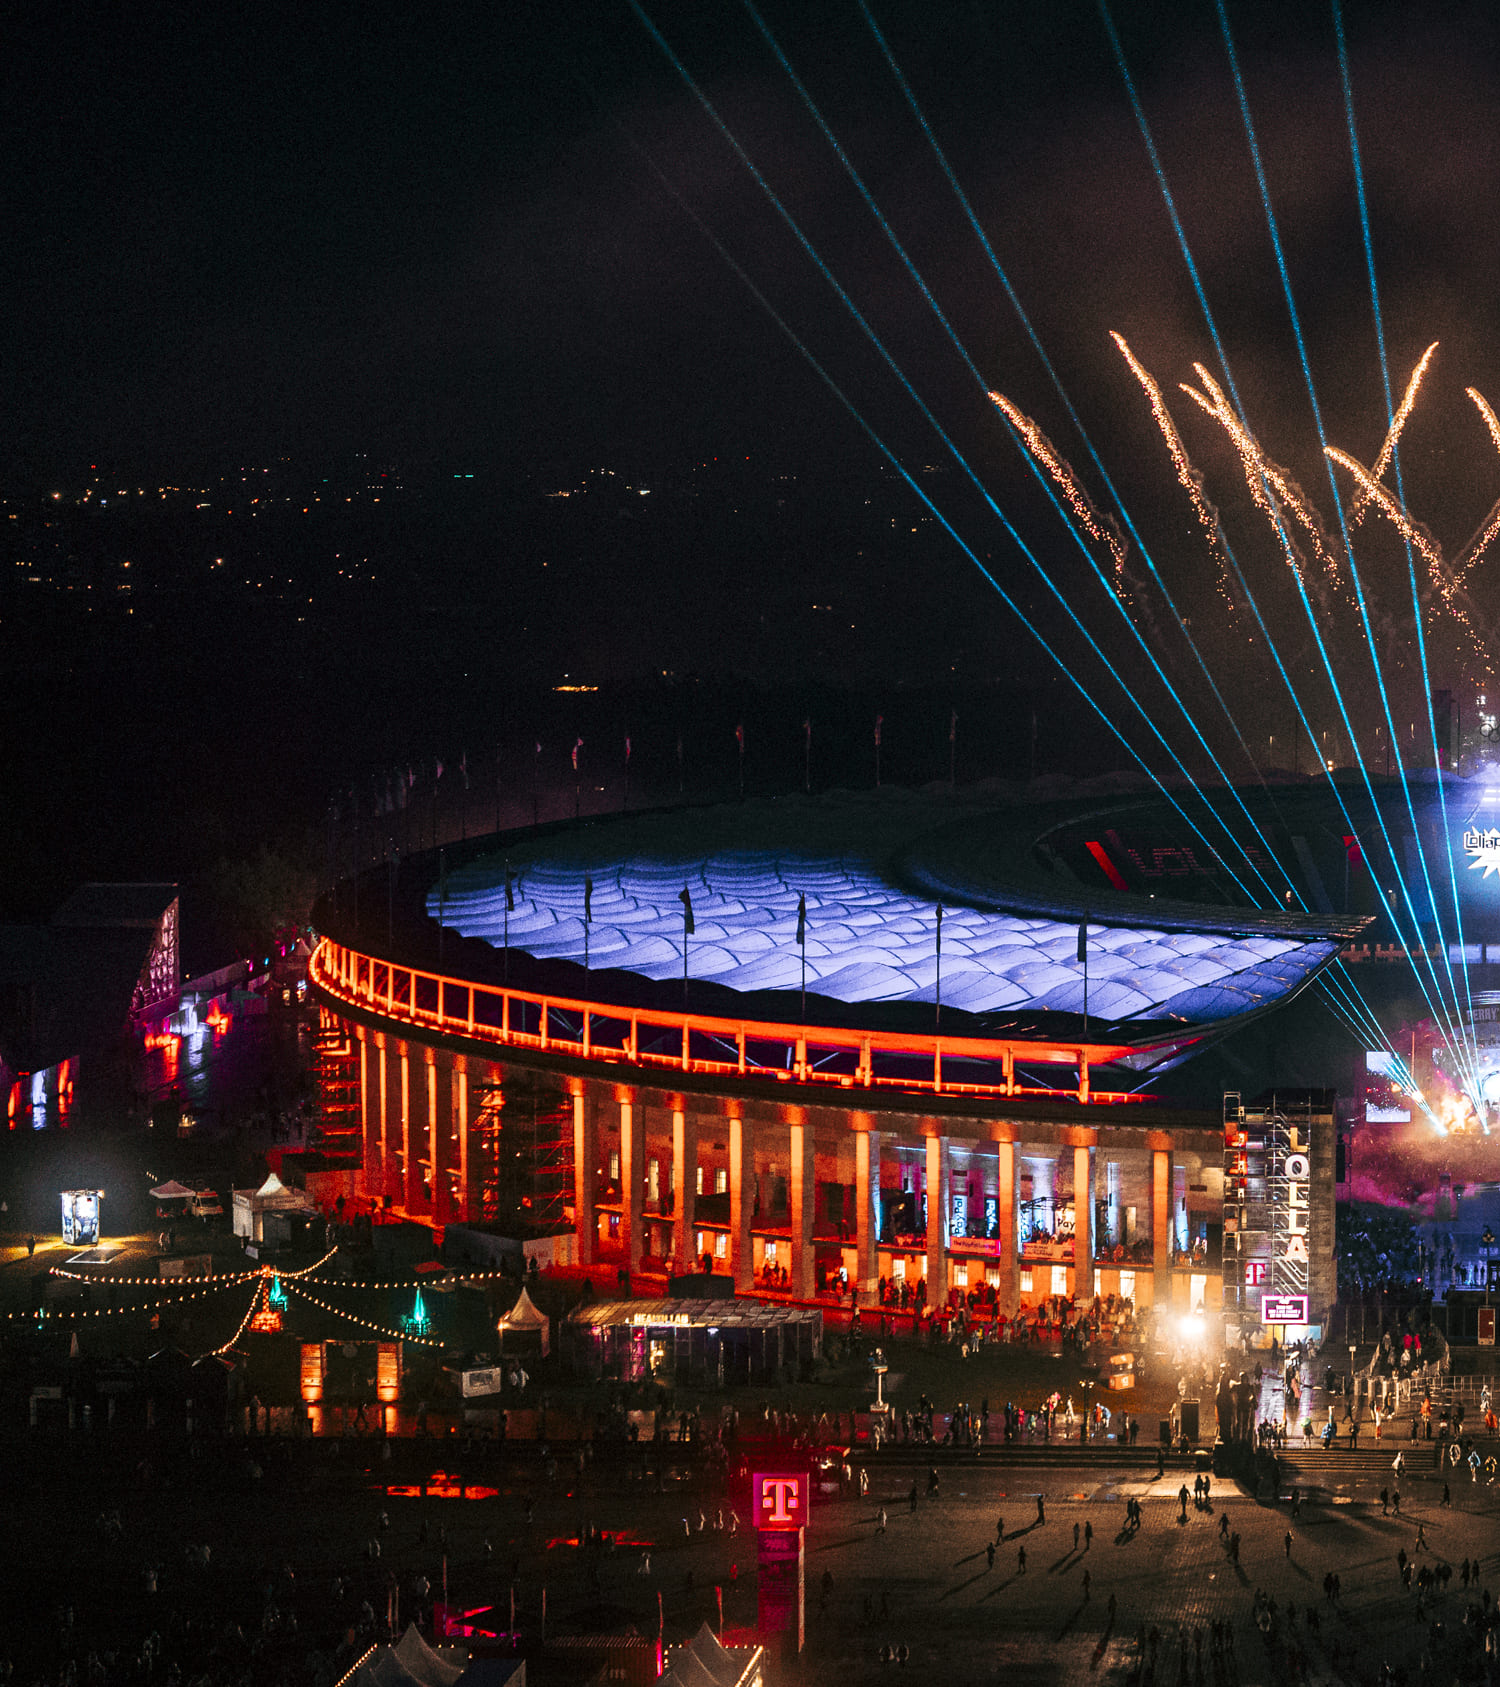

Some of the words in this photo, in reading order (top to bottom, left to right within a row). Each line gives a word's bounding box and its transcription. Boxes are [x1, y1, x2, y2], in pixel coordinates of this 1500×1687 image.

[954, 1198, 966, 1235] PayPal
[1284, 1126, 1310, 1263] LOLLA
[762, 1478, 799, 1522] T
